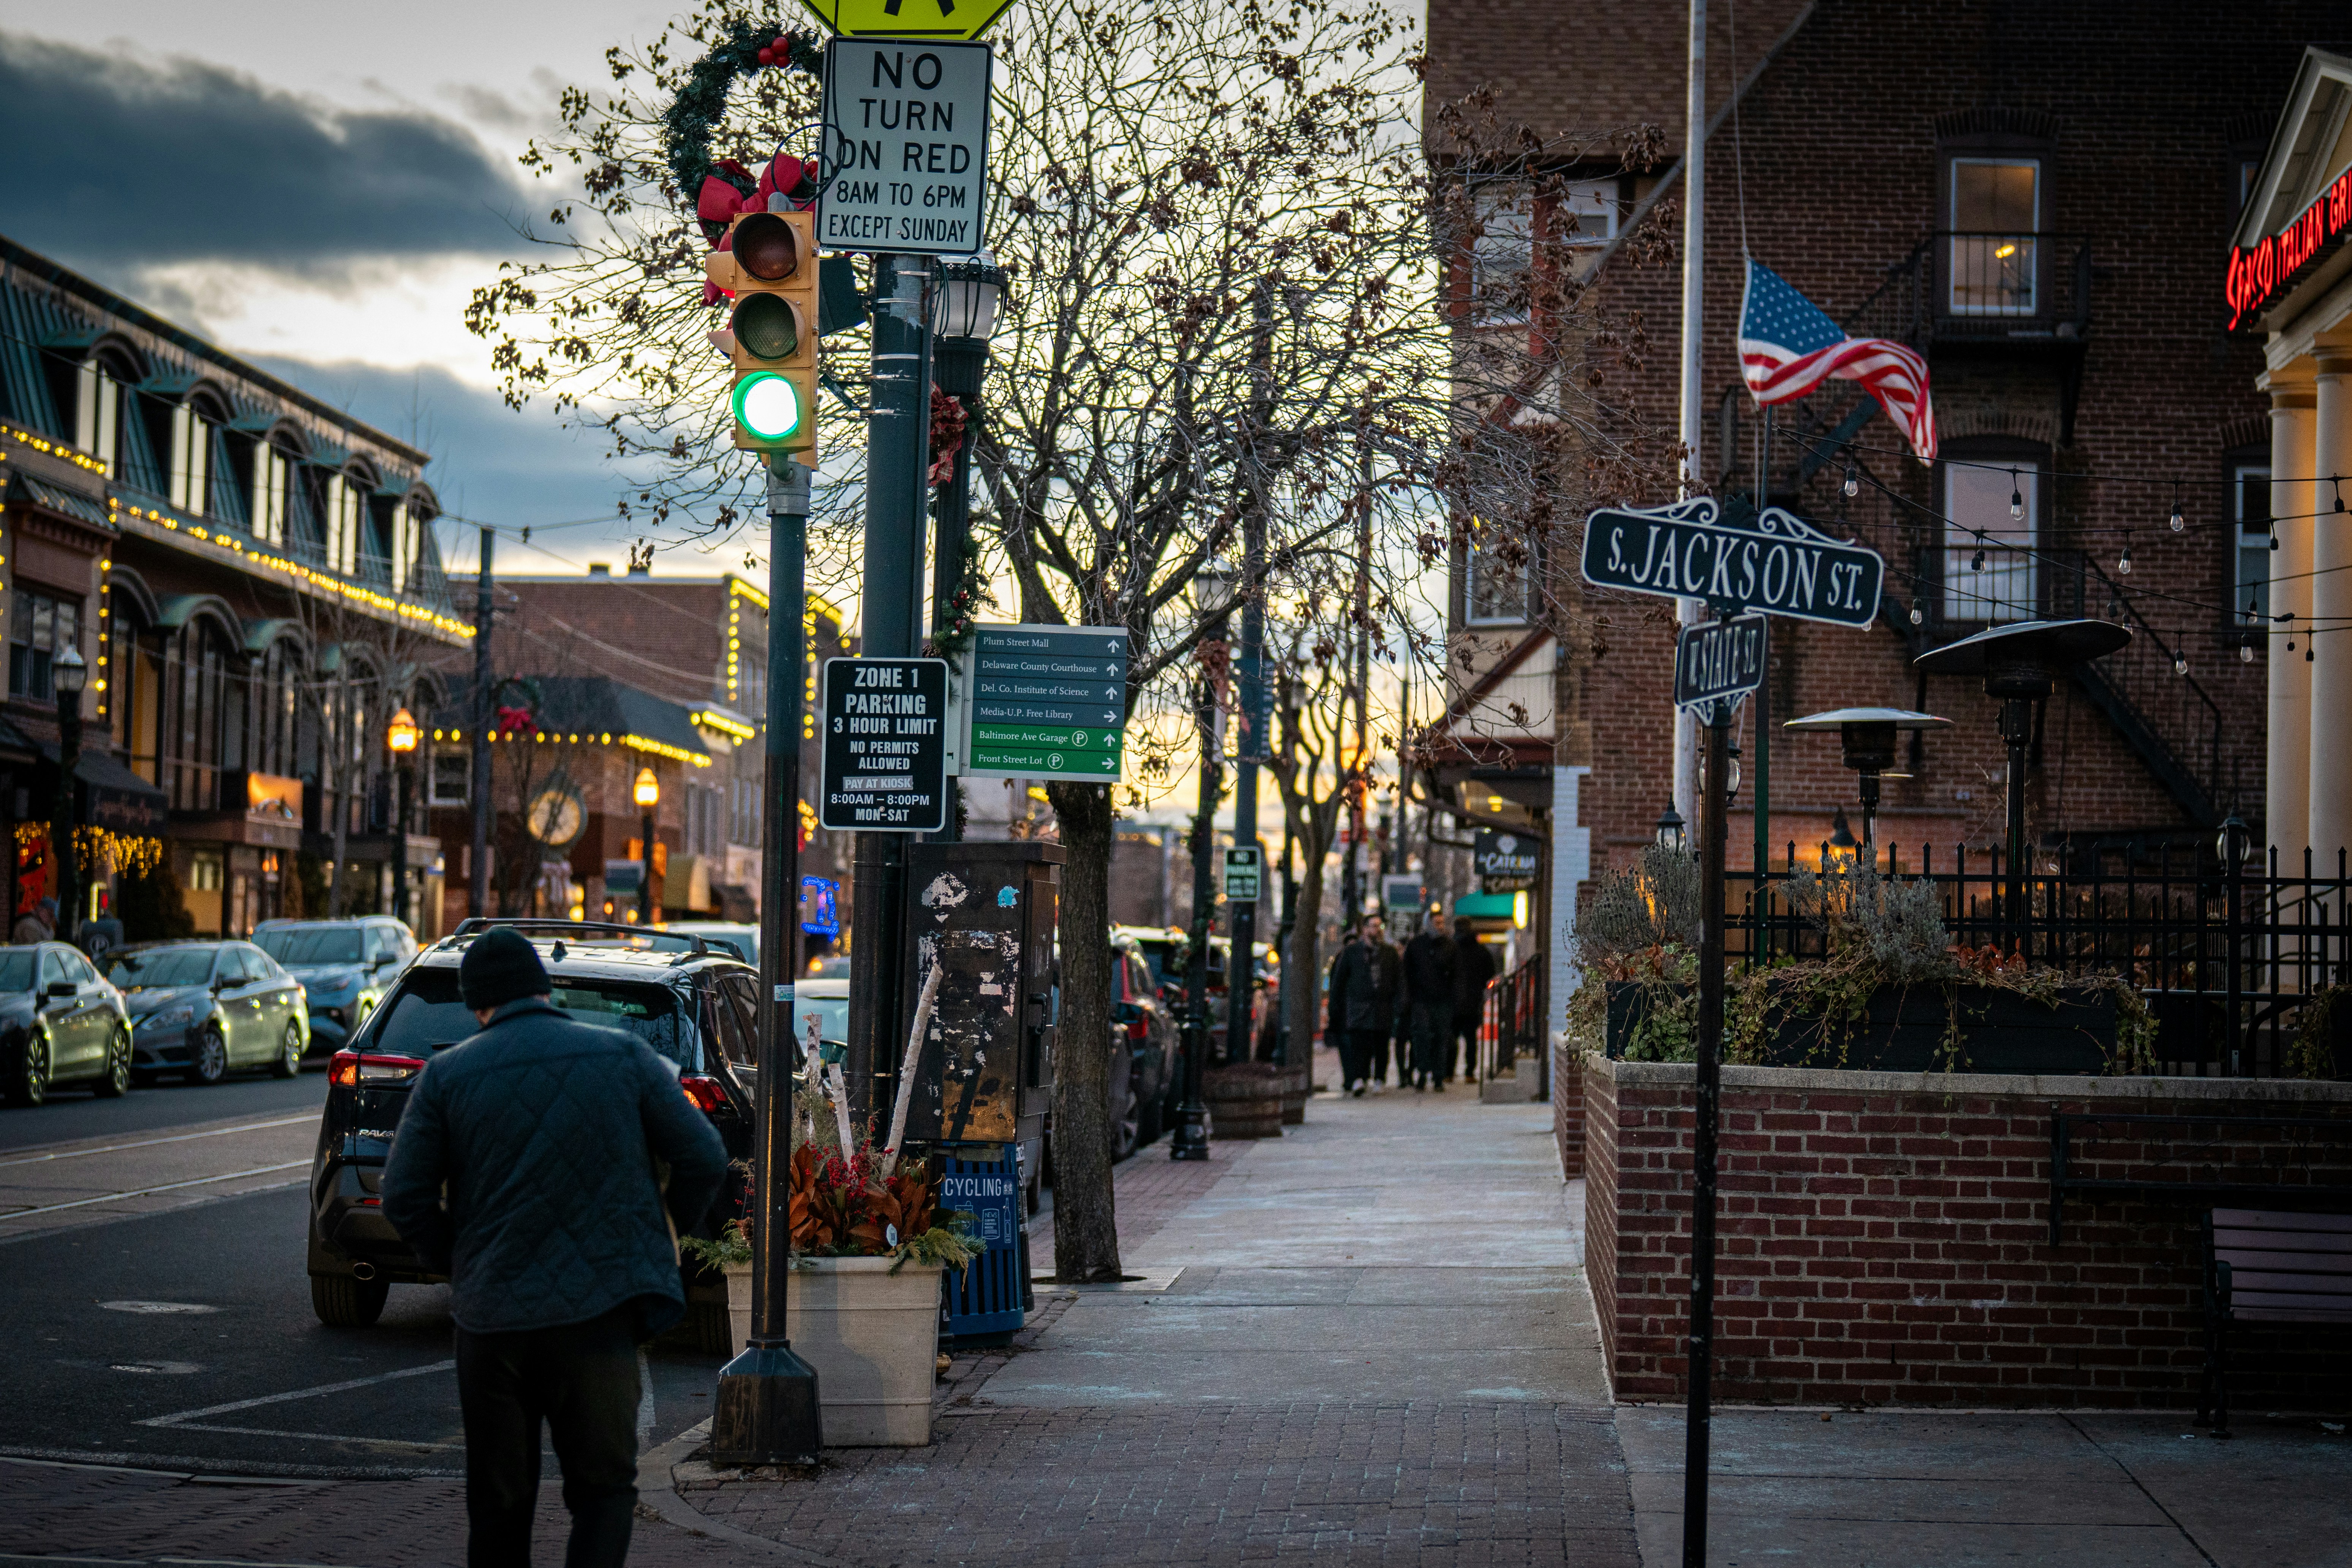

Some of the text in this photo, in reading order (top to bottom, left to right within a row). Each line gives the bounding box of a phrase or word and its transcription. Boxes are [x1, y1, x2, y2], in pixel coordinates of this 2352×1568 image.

[873, 51, 942, 90] NO
[859, 98, 953, 132] TURN
[837, 138, 971, 174] ON RED
[836, 180, 966, 209] 8AM TO 6PM
[829, 214, 969, 243] EXCEPT SUNDAY
[2276, 198, 2324, 286] ITALIAN
[1608, 525, 1863, 610] S. JACKSON ST.
[983, 637, 1004, 645] Plum
[982, 660, 1097, 673] Delaware County Courthouse
[1699, 626, 1741, 692] STATE
[855, 668, 918, 688] ZONE 1
[1015, 686, 1047, 694] Institute
[1049, 686, 1059, 695] of
[1059, 688, 1089, 696] Science
[846, 694, 926, 714] PARKING
[980, 707, 1024, 717] Media-U.P.
[1046, 710, 1073, 721] Library
[834, 717, 937, 735] 3 HOUR LIMIT
[979, 731, 1019, 740] Baltimore
[1039, 733, 1068, 744] Garage
[850, 741, 919, 754] NO PERMITS
[858, 757, 910, 770] ALLOWED
[978, 754, 1000, 763] Front
[1003, 755, 1027, 763] Street
[1029, 756, 1043, 765] Lot
[845, 778, 912, 789] PAY AT KIOSK
[831, 794, 874, 804] 8:00AM
[887, 795, 929, 805] 8:00PM
[855, 808, 910, 822] MON-SAT
[359, 1129, 394, 1138] RAV4
[941, 1178, 1001, 1196] CYCLING
